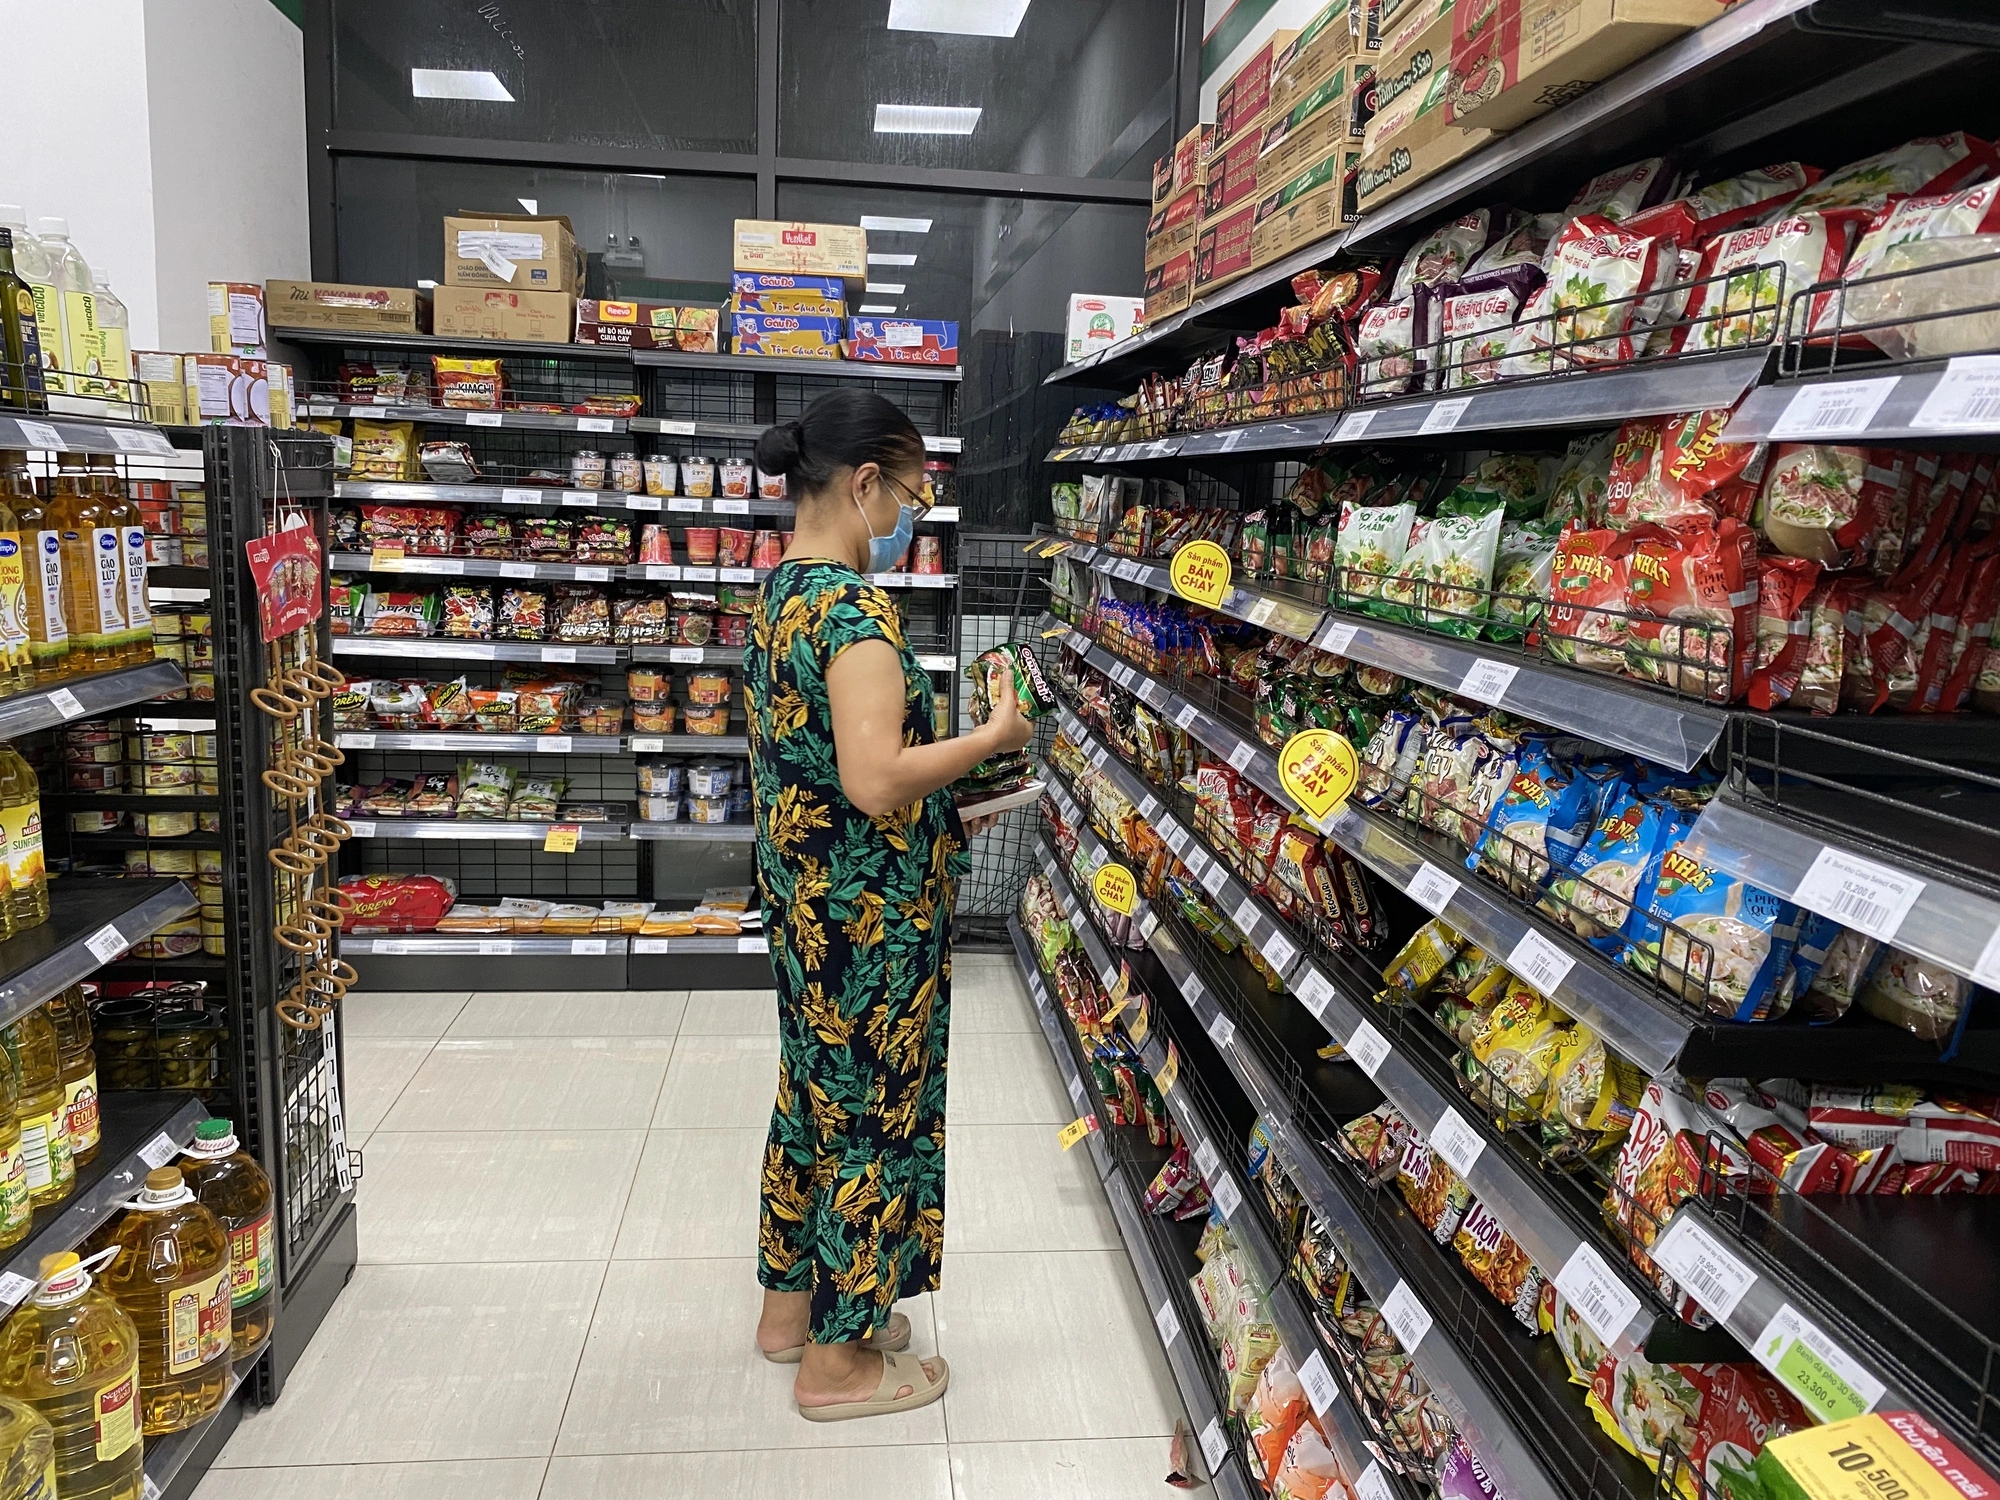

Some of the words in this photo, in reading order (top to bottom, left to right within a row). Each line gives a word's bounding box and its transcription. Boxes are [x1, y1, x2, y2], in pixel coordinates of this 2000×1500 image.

[607, 305, 631, 317] Reeva
[600, 334, 617, 342] CHUA
[618, 335, 630, 343] CAY
[458, 383, 495, 394] KIMCHI
[0, 541, 17, 553] imply
[100, 538, 117, 547] Simply
[129, 535, 144, 545] Simply
[1187, 551, 1201, 563] Sản
[1201, 556, 1224, 570] phẩm
[1571, 553, 1614, 585] NHẤT
[1188, 564, 1215, 581] BÁN
[1179, 574, 1216, 594] CHẠY
[1021, 647, 1048, 697] Omachi
[433, 682, 461, 709] KORENO
[477, 702, 512, 715] KORENO
[1310, 738, 1327, 756] Sản
[1325, 754, 1349, 779] phẩm
[1302, 753, 1334, 785] BÁN
[1288, 761, 1330, 799] CHẠY
[1103, 869, 1114, 880] Sản
[1664, 853, 1718, 895] NHẤT
[1855, 869, 1871, 881] Coop
[1871, 875, 1888, 887] Select
[1099, 887, 1126, 904] CHẠY
[1104, 879, 1125, 894] BÁN
[1350, 878, 1367, 912] NEOGURI
[353, 896, 398, 916] KORENO
[1322, 882, 1339, 916] NEOGURI
[72, 1105, 97, 1127] GOLD
[1797, 1370, 1828, 1401] 23,300
[1827, 1399, 1837, 1409] đ
[1822, 1371, 1837, 1386] pho
[1848, 1392, 1867, 1414] 500g
[1888, 1417, 1950, 1468] khuyến
[1944, 1468, 1989, 1500] mãi
